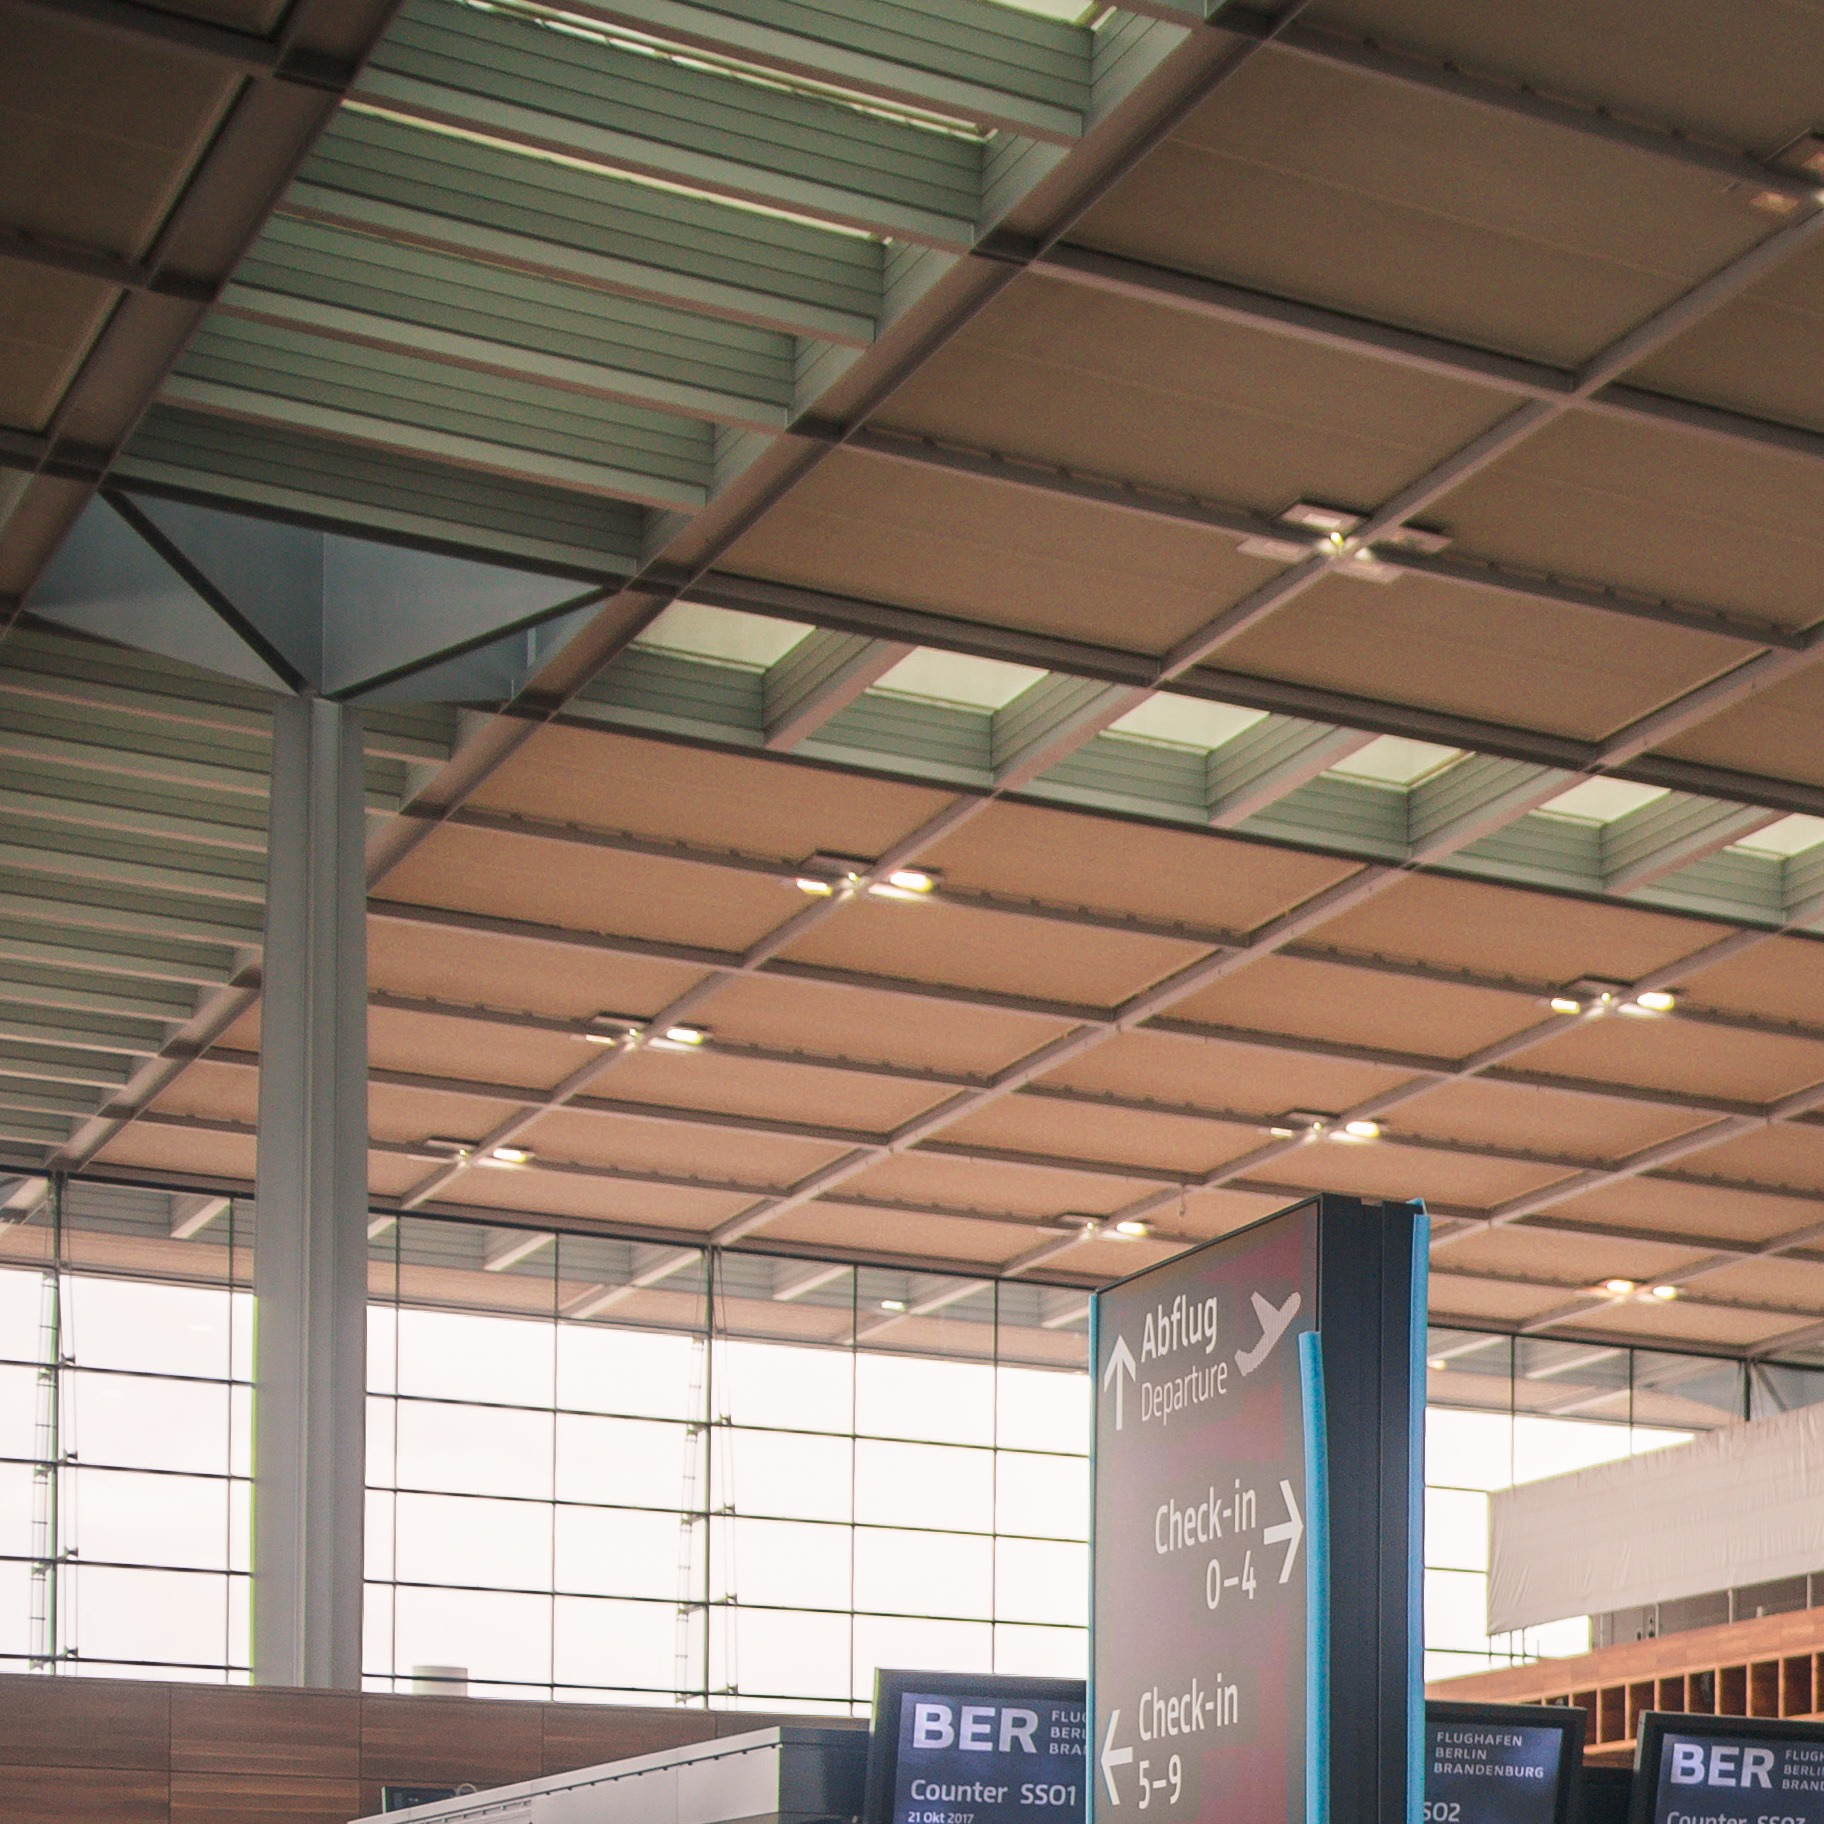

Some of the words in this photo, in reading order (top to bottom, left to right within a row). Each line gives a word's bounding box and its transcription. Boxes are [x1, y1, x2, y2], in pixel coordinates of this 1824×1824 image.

[1140, 1294, 1218, 1363] Abflug
[1141, 1362, 1228, 1426] Departure
[1155, 1479, 1256, 1554] Check-in
[1139, 1673, 1238, 1741] Check-in
[913, 1703, 1039, 1753] BER
[1437, 1731, 1523, 1747] FLUGHAFEN
[1049, 1743, 1086, 1756] BRA
[1435, 1747, 1487, 1760] BERLIN
[1670, 1743, 1775, 1789] BER
[1433, 1763, 1544, 1779] BRANDENBURG
[911, 1779, 1008, 1804] Counter
[908, 1811, 921, 1823] 21
[923, 1812, 945, 1823] Okt
[947, 1813, 974, 1824] 2017
